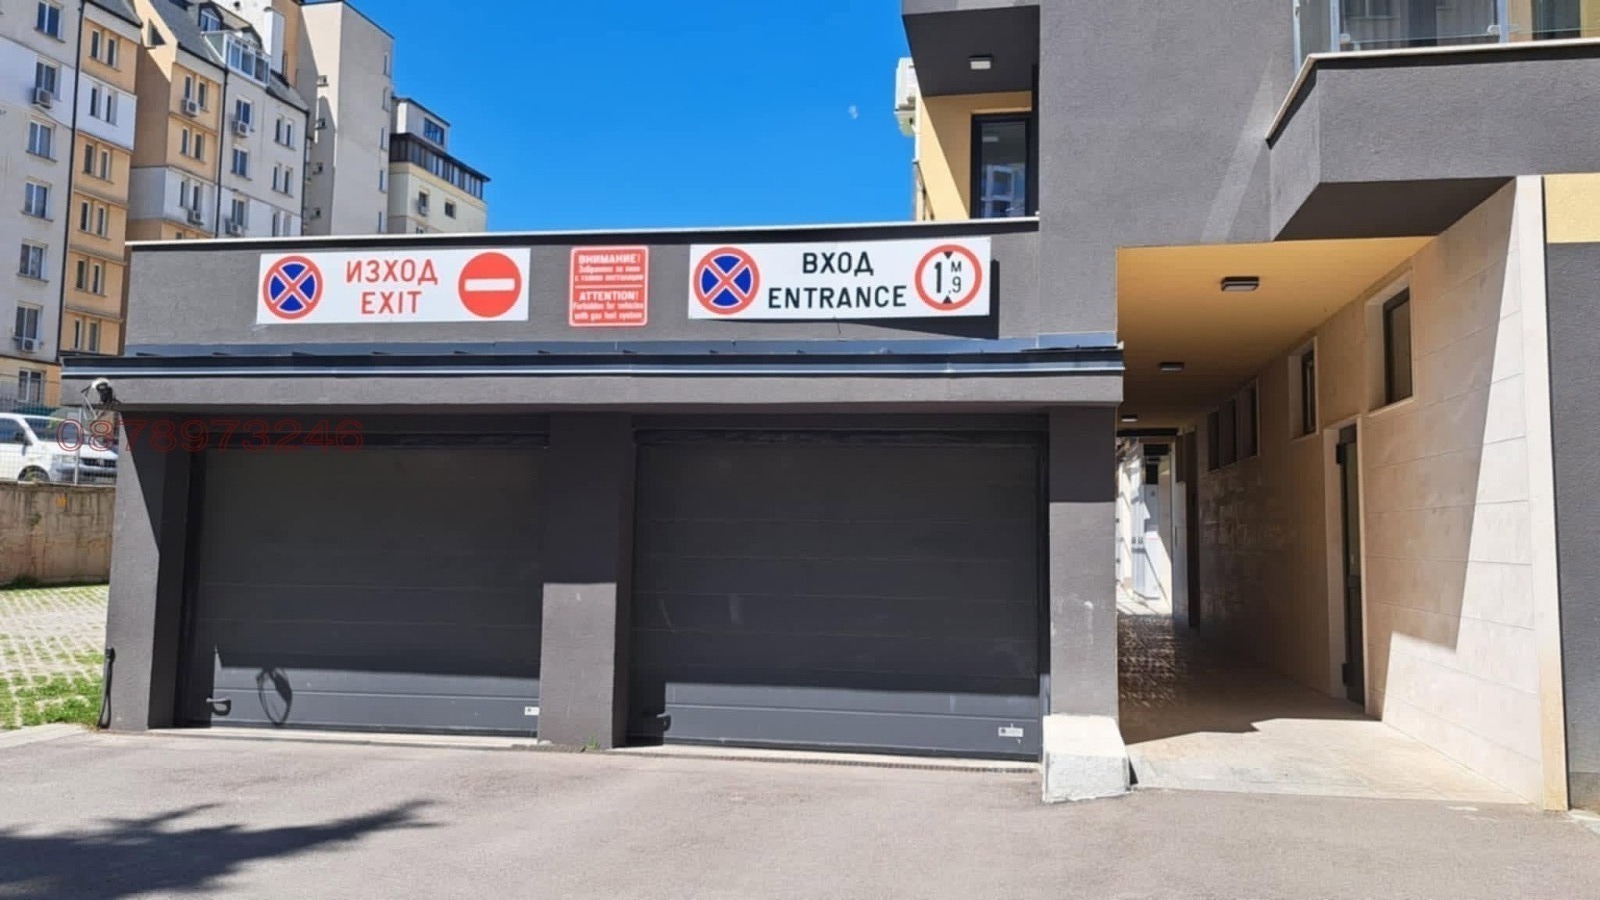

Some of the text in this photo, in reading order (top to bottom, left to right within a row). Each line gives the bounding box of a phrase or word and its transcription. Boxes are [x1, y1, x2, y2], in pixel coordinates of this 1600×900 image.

[578, 253, 641, 264] ВНИМАНИЕ!
[802, 251, 874, 276] ВХОД
[346, 258, 438, 285] ИЗХОД
[361, 291, 423, 315] EXIT
[579, 290, 639, 301] ATTENTION!
[768, 284, 907, 309] ENTRANCE
